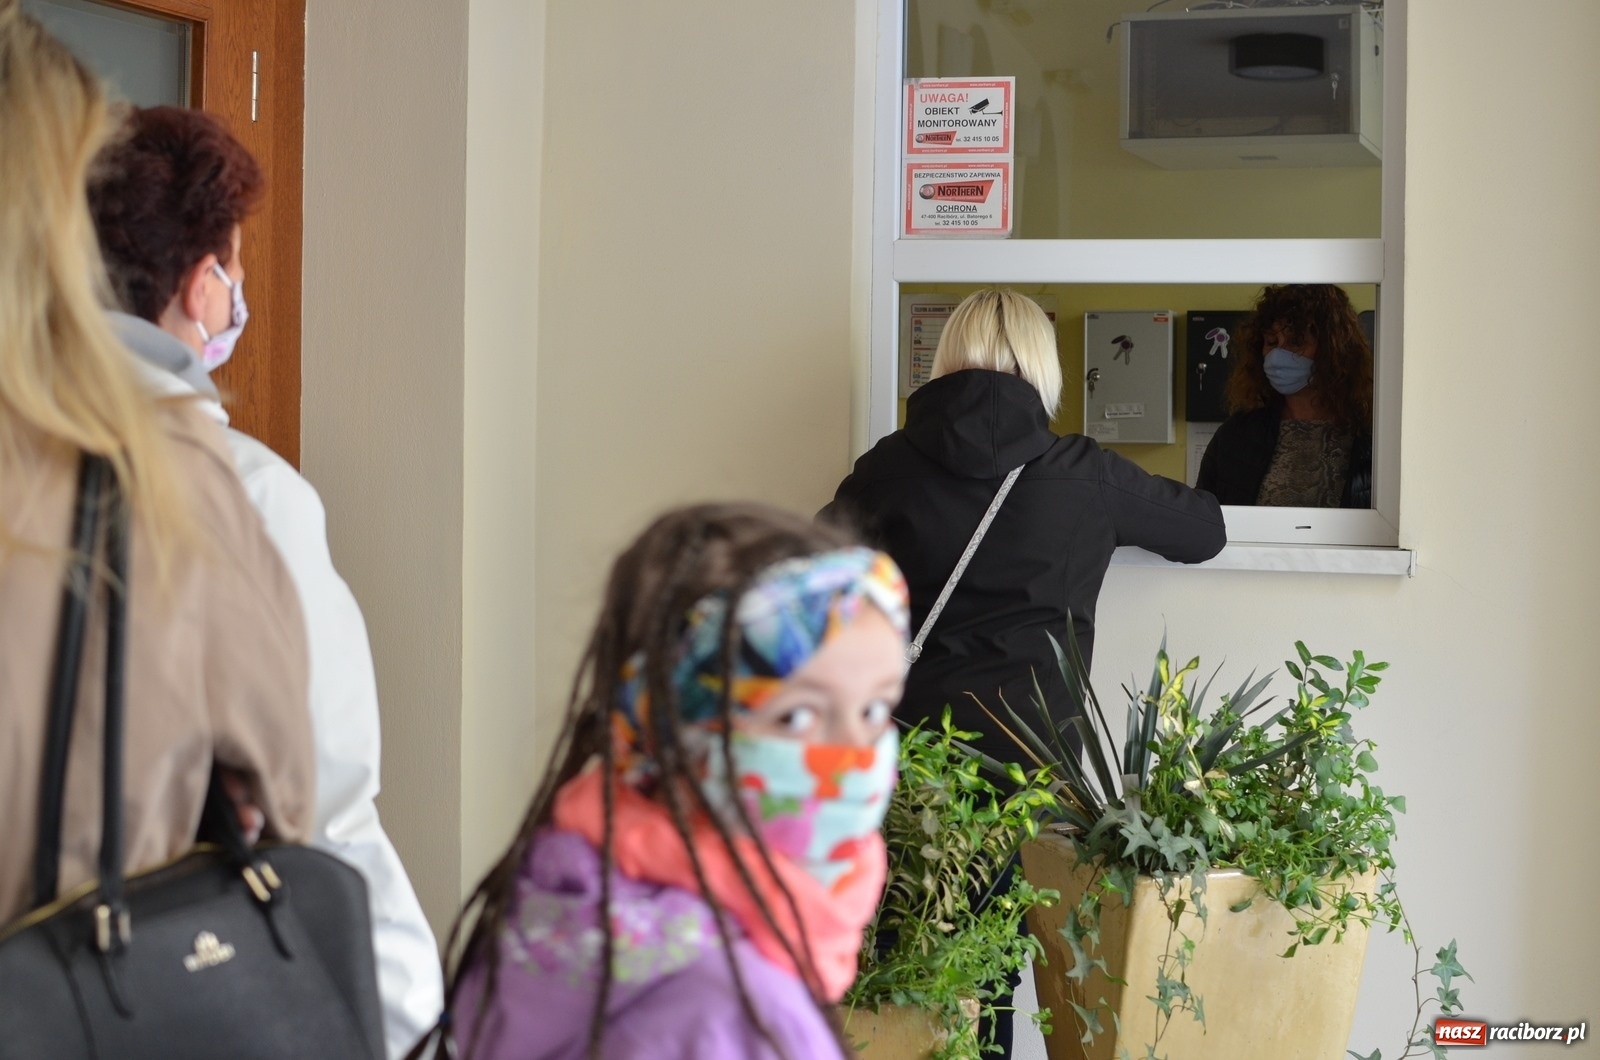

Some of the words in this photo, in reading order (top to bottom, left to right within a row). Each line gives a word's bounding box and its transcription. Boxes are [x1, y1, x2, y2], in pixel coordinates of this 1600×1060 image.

[920, 94, 968, 103] UWAGA!
[925, 107, 960, 115] OBIEKT
[918, 119, 997, 128] MONITOROWANY
